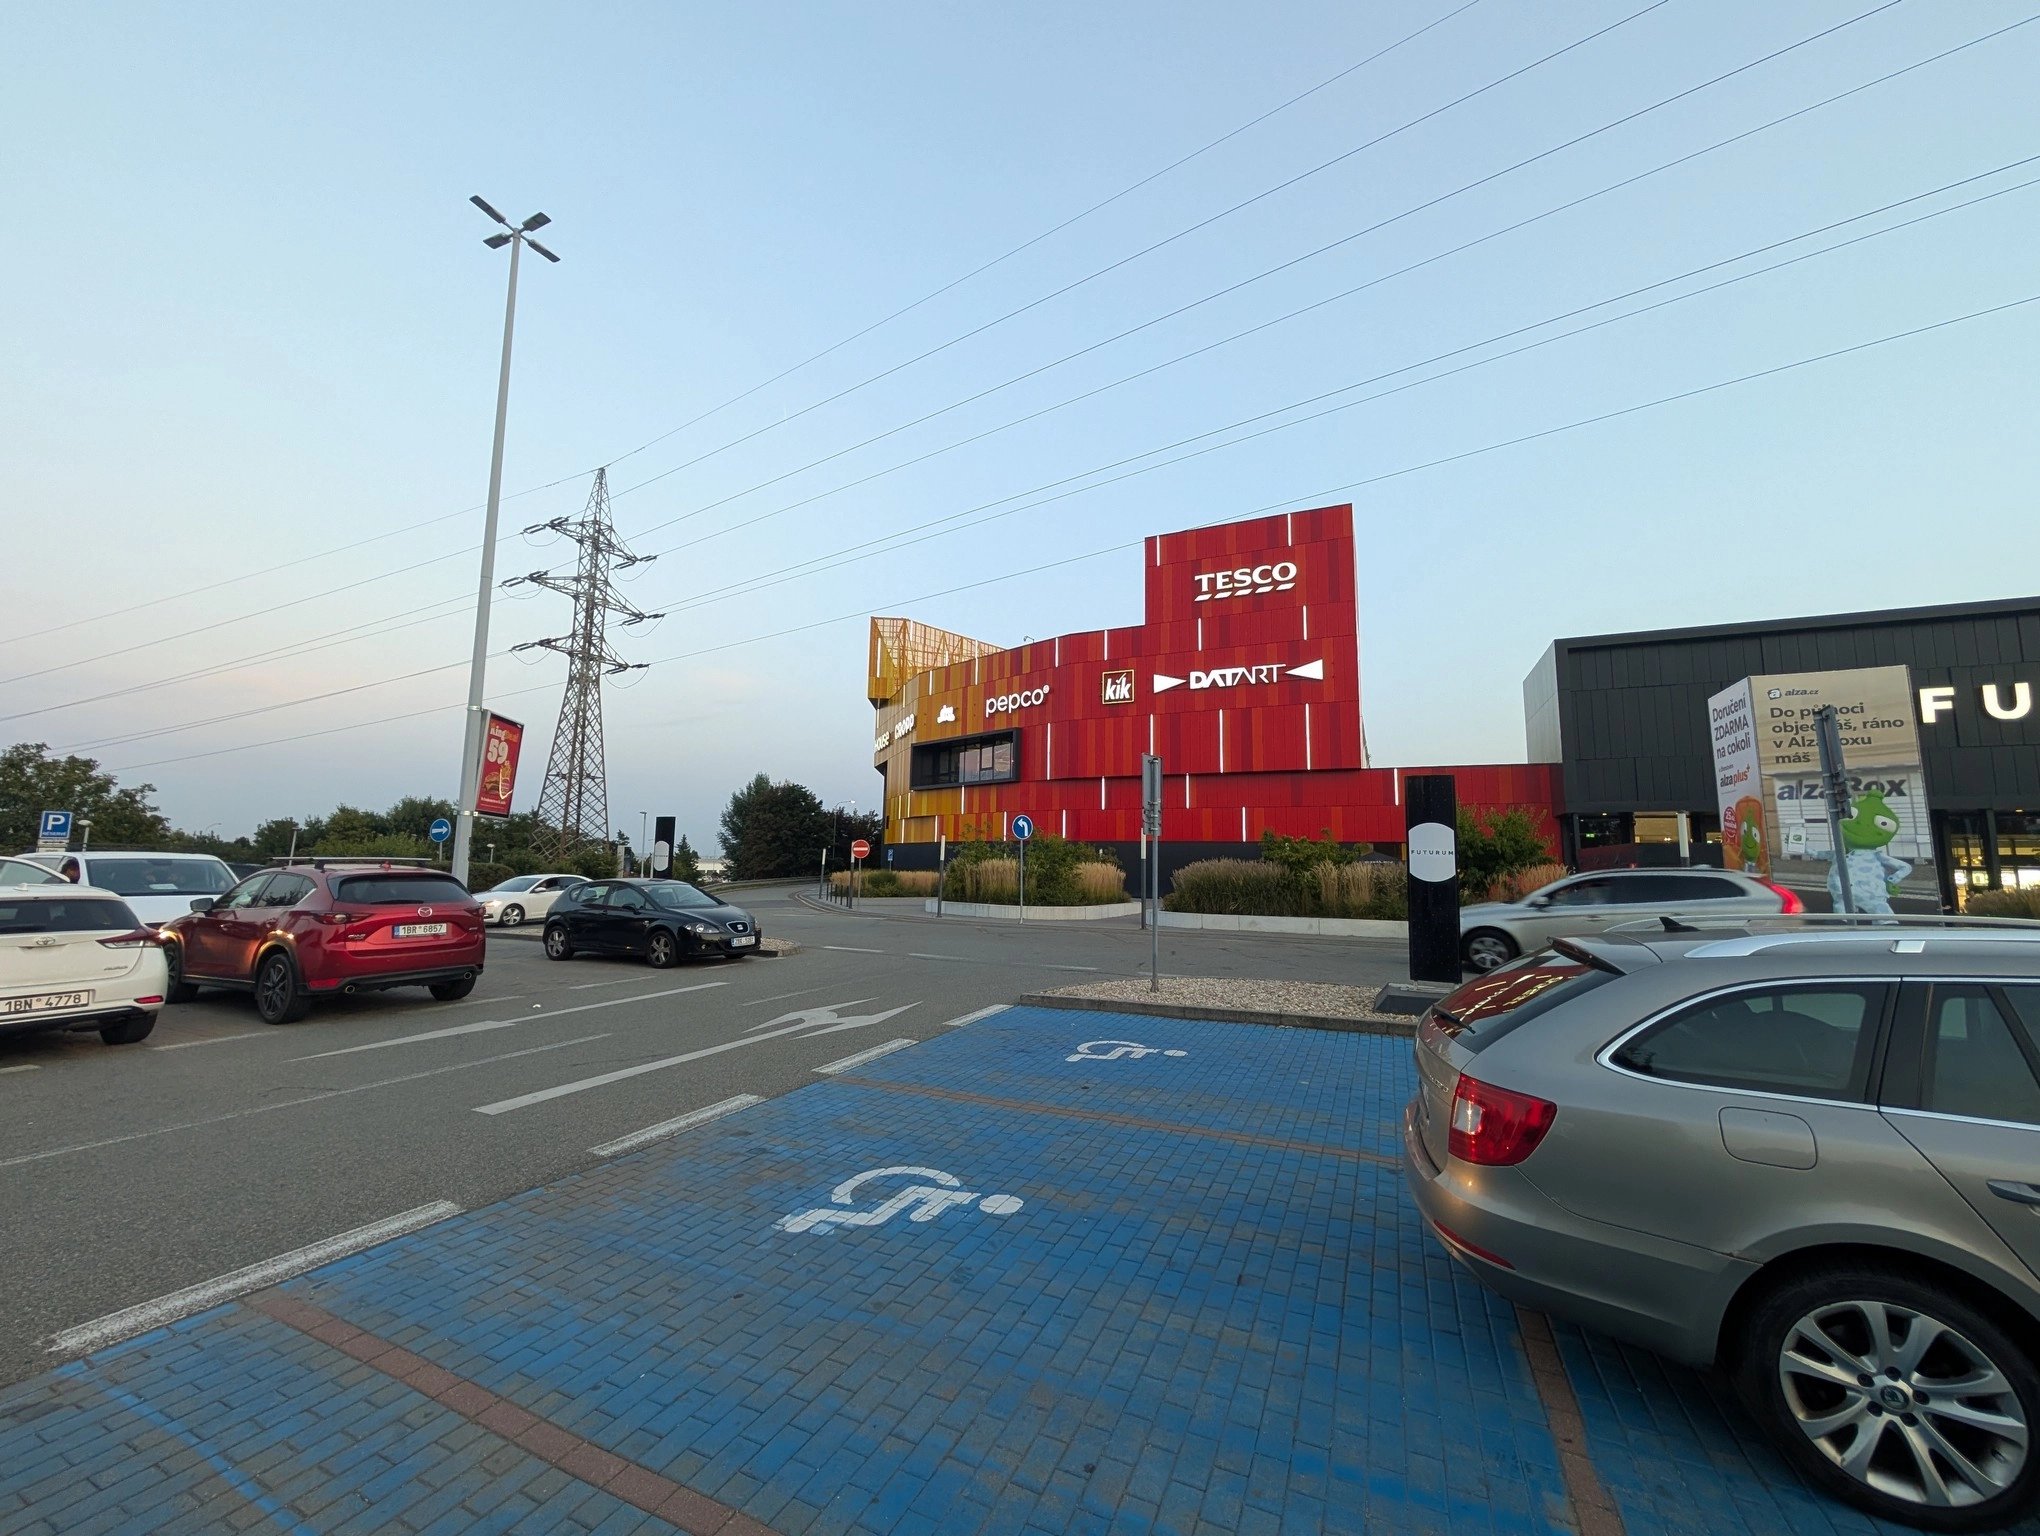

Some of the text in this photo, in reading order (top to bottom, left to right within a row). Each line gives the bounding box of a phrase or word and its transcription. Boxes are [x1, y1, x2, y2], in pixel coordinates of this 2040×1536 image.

[1194, 562, 1297, 592] TESCO
[1105, 673, 1131, 701] kik
[1190, 663, 1287, 690] DATART
[1784, 688, 1819, 697] alza.cz
[1919, 682, 2031, 723] FU
[1712, 692, 1747, 722] Doručení
[1770, 707, 1795, 718] Do
[1714, 714, 1750, 742] ZDARMA
[1862, 717, 1905, 729] ráno
[487, 738, 508, 764] 59
[1716, 732, 1751, 760] na cokoli
[1773, 736, 1872, 749] v Alzoxu
[1775, 752, 1811, 764] máš
[46, 814, 66, 831] P
[402, 924, 443, 934] 1BR 6857
[4, 994, 82, 1013] 1BN 4778
